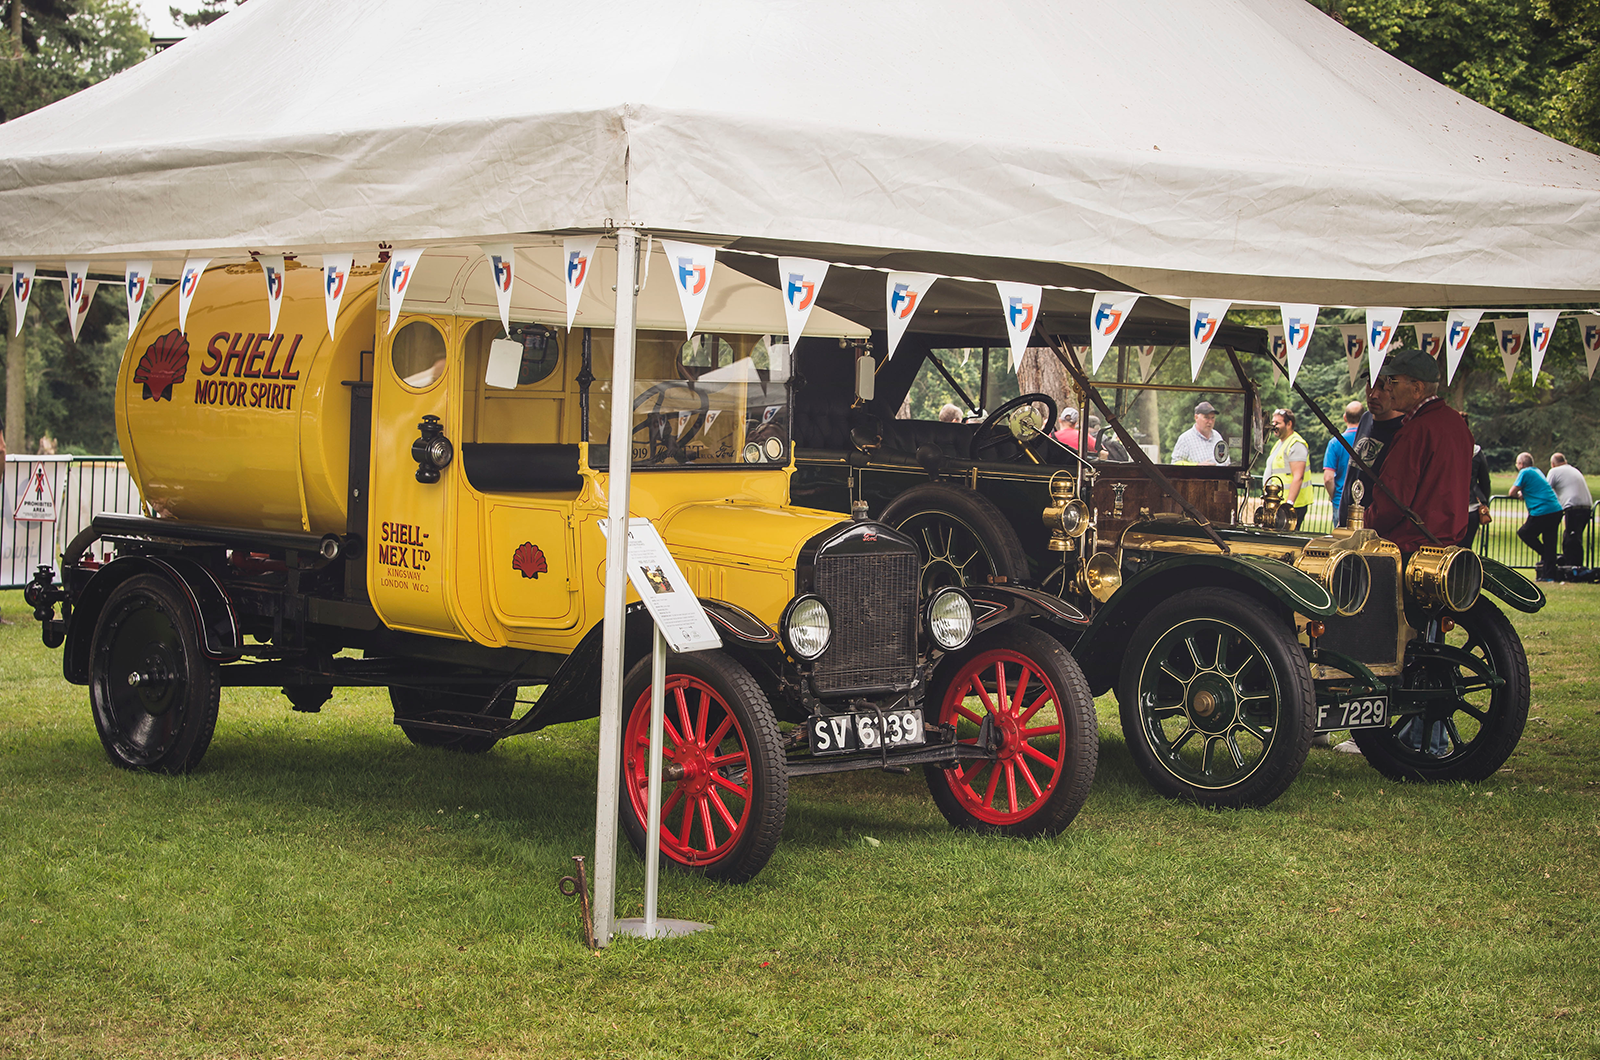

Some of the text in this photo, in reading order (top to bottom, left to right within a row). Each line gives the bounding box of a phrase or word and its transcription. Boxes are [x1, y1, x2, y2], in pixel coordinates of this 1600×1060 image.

[200, 331, 303, 380] SHELL
[194, 379, 296, 410] MOTOR SPIRIT
[378, 544, 409, 568] MEX
[380, 577, 409, 590] LONDON
[387, 567, 421, 581] KINGSWAY
[1339, 700, 1384, 726] 7229
[815, 713, 919, 750] SV 6239
